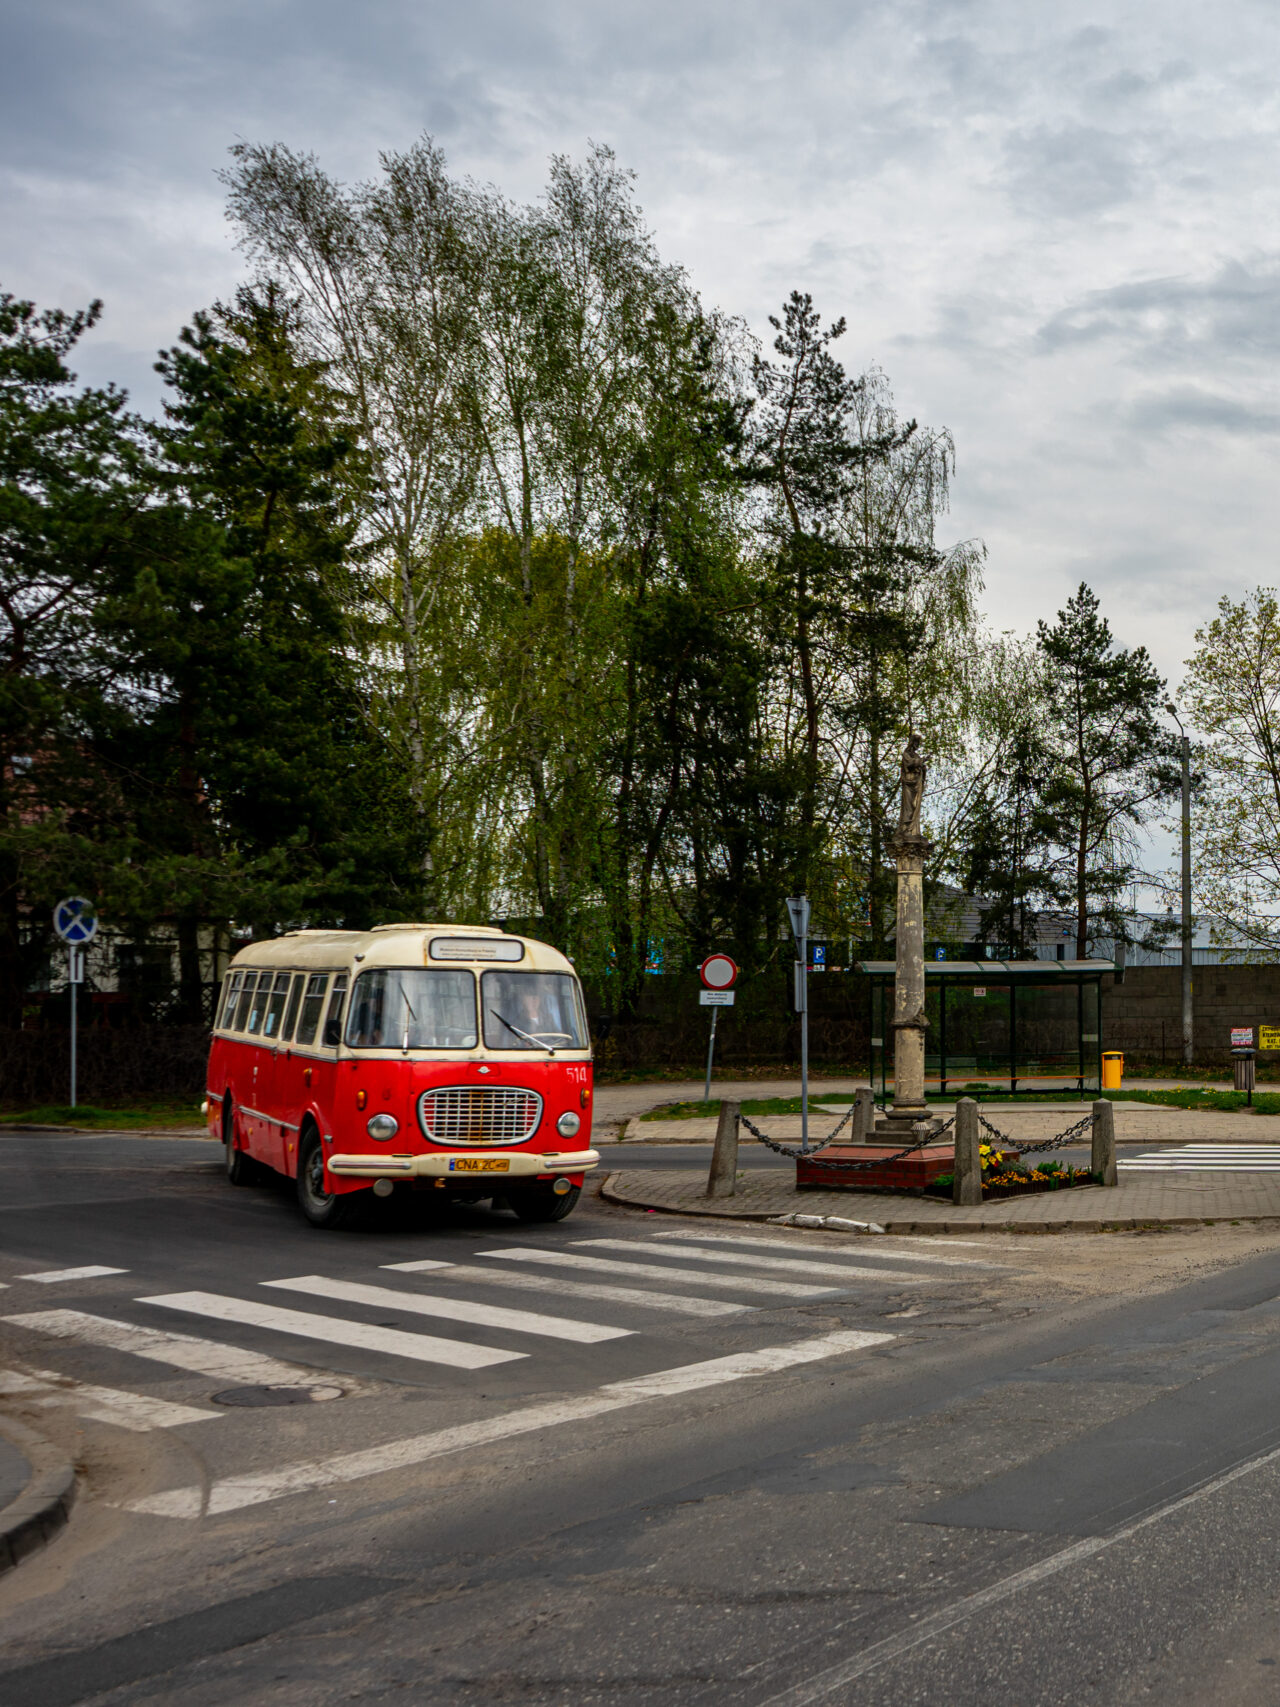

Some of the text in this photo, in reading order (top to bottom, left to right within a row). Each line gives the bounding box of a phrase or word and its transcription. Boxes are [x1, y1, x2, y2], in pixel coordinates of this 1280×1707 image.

[566, 1066, 587, 1084] 514
[455, 1159, 497, 1170] CNA 2C
